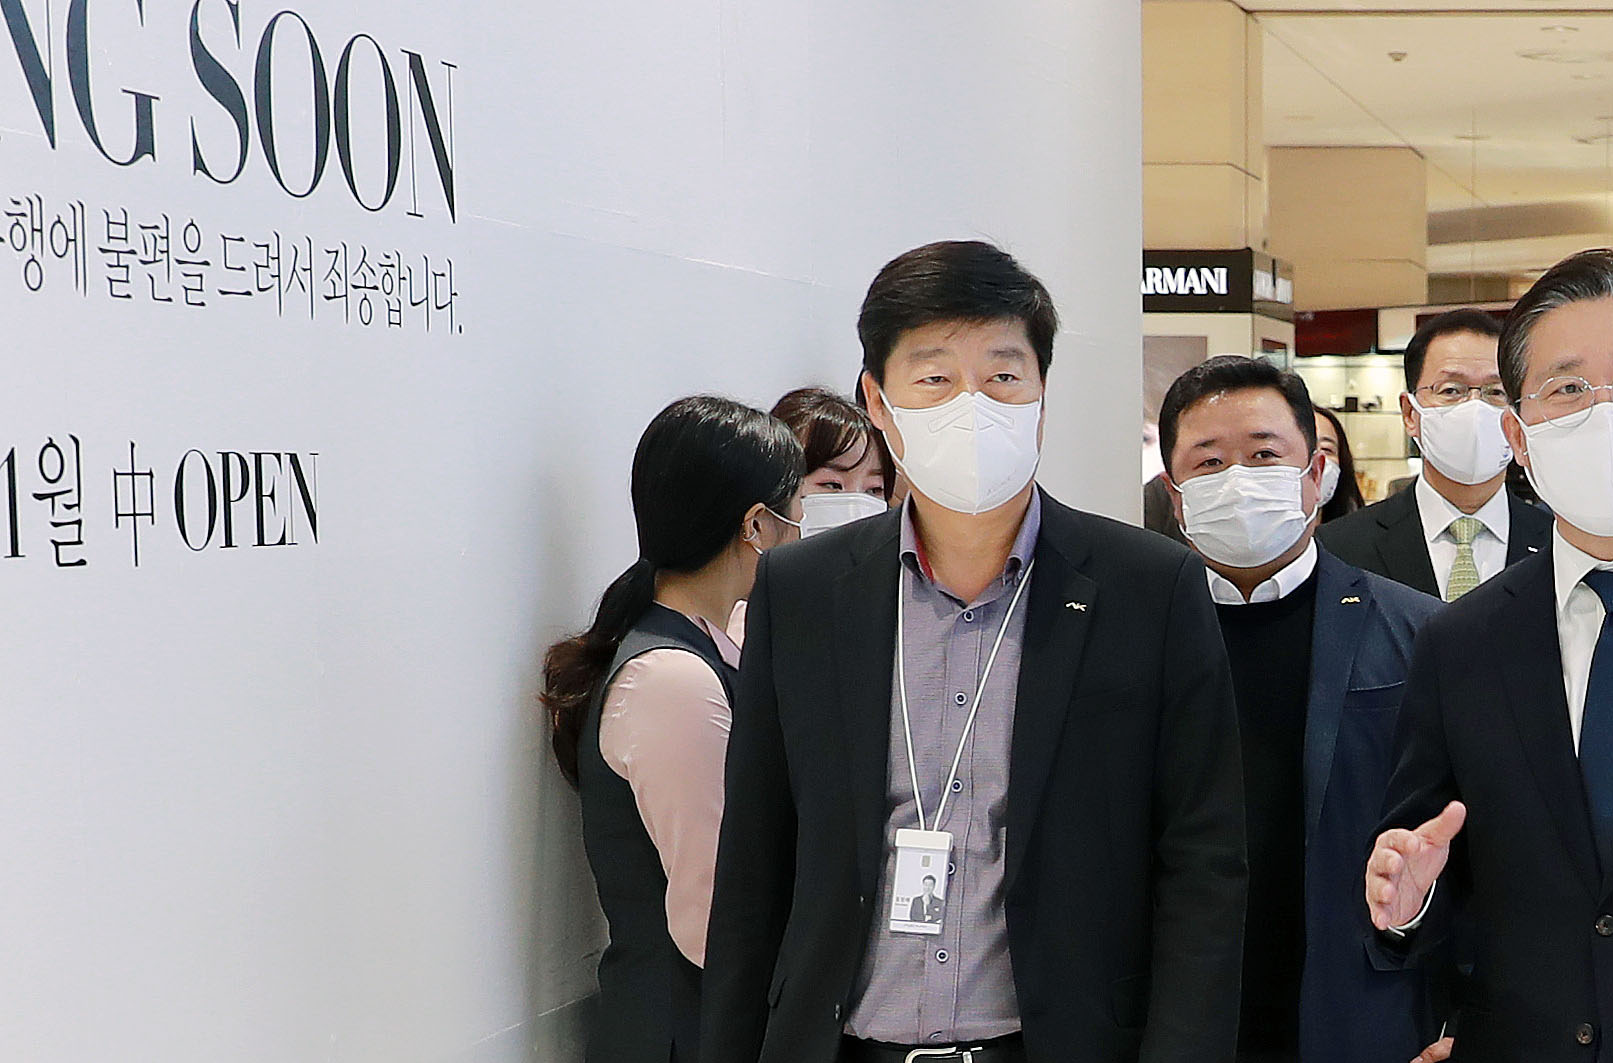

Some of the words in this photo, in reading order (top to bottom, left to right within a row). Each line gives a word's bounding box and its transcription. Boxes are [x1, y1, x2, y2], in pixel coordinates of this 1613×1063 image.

[0, 0, 160, 166] NG
[189, 0, 457, 224] SOON
[0, 193, 87, 298] 행에
[98, 207, 210, 307] 불편을
[217, 231, 314, 320] 드려서
[322, 241, 463, 334] 죄송합니다.
[0, 435, 87, 567] 1월
[113, 442, 155, 567] 中
[173, 448, 319, 552] OPEN
